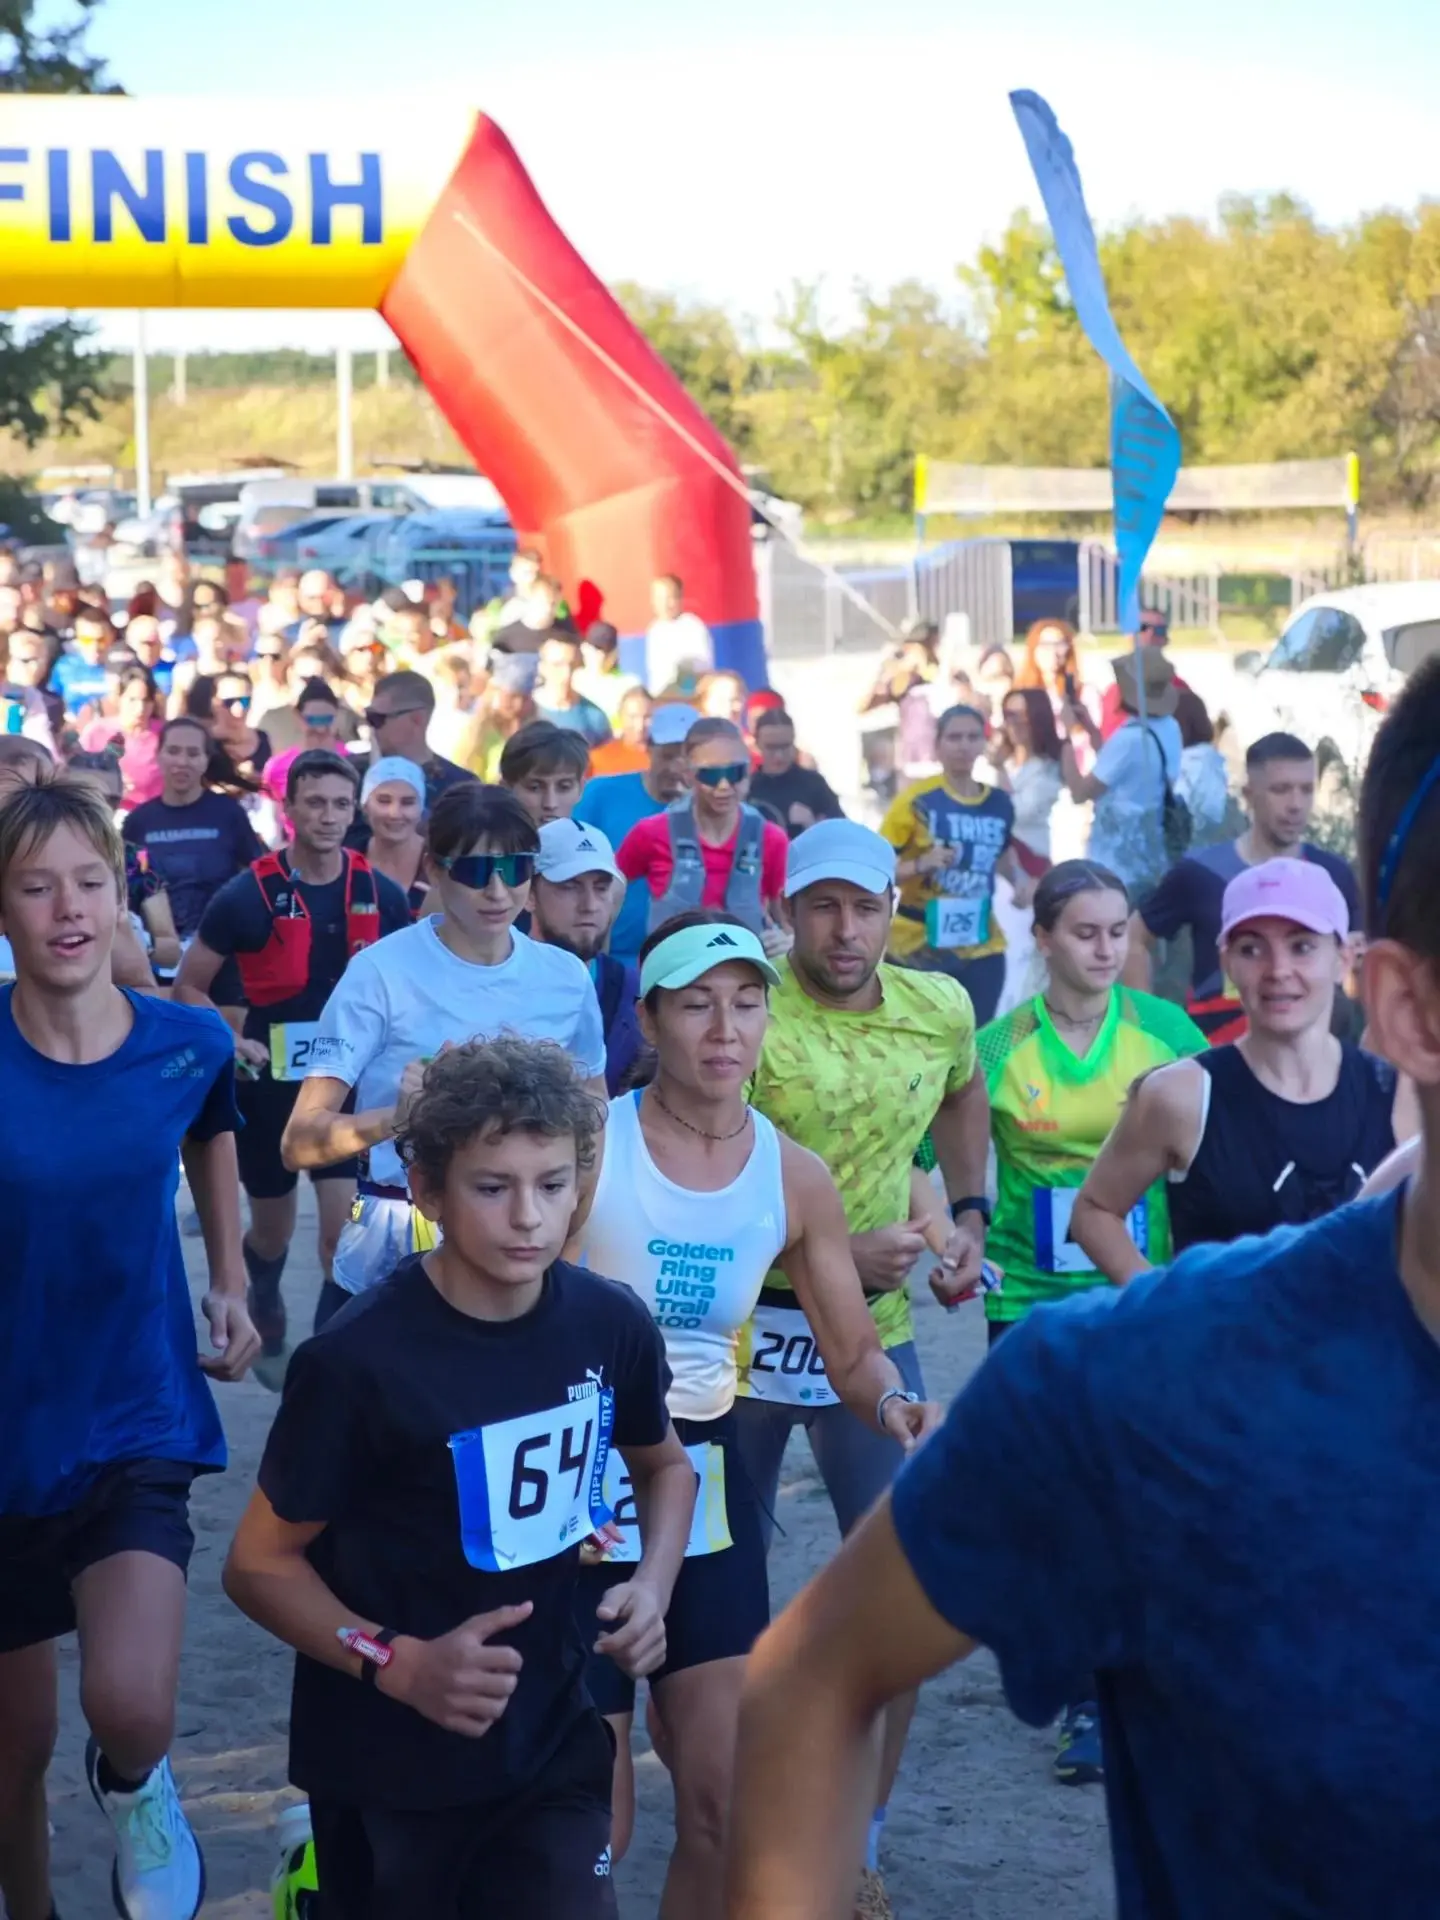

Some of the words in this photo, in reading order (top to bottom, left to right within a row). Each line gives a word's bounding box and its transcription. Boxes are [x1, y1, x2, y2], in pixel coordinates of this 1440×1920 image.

[647, 1239, 734, 1262] Golden
[660, 1259, 716, 1284] Ring
[655, 1279, 716, 1299] Ultra
[655, 1297, 710, 1317] Trail
[652, 1315, 702, 1330] 100
[567, 1380, 597, 1402] PUMA
[508, 1418, 593, 1521] 64
